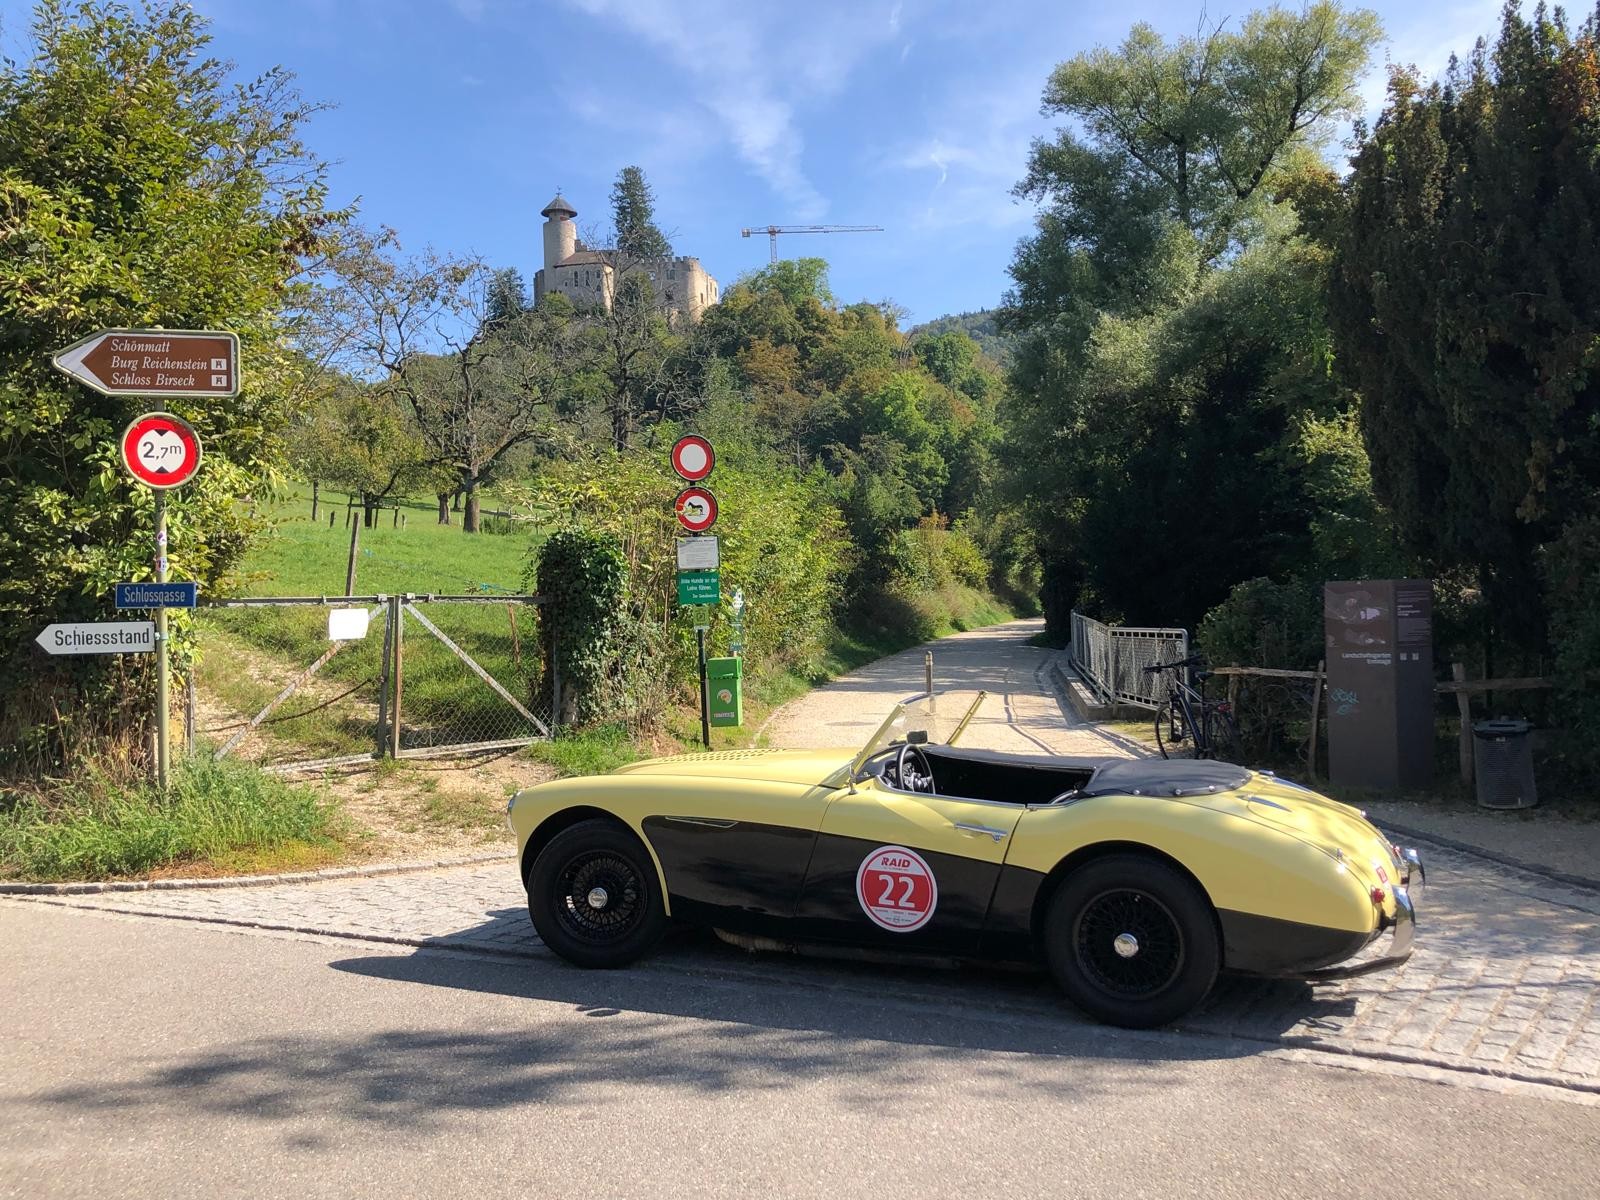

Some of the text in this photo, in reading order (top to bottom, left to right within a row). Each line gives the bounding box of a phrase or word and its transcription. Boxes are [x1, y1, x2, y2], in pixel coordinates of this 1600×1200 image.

[111, 338, 170, 353] Schönmatt
[112, 356, 208, 371] Burg Reichenstein
[112, 372, 195, 387] Schloss Birseck
[125, 586, 185, 605] Schlossgasse
[55, 627, 150, 648] Schiessstand
[881, 856, 911, 868] RAID
[878, 874, 915, 908] 22
